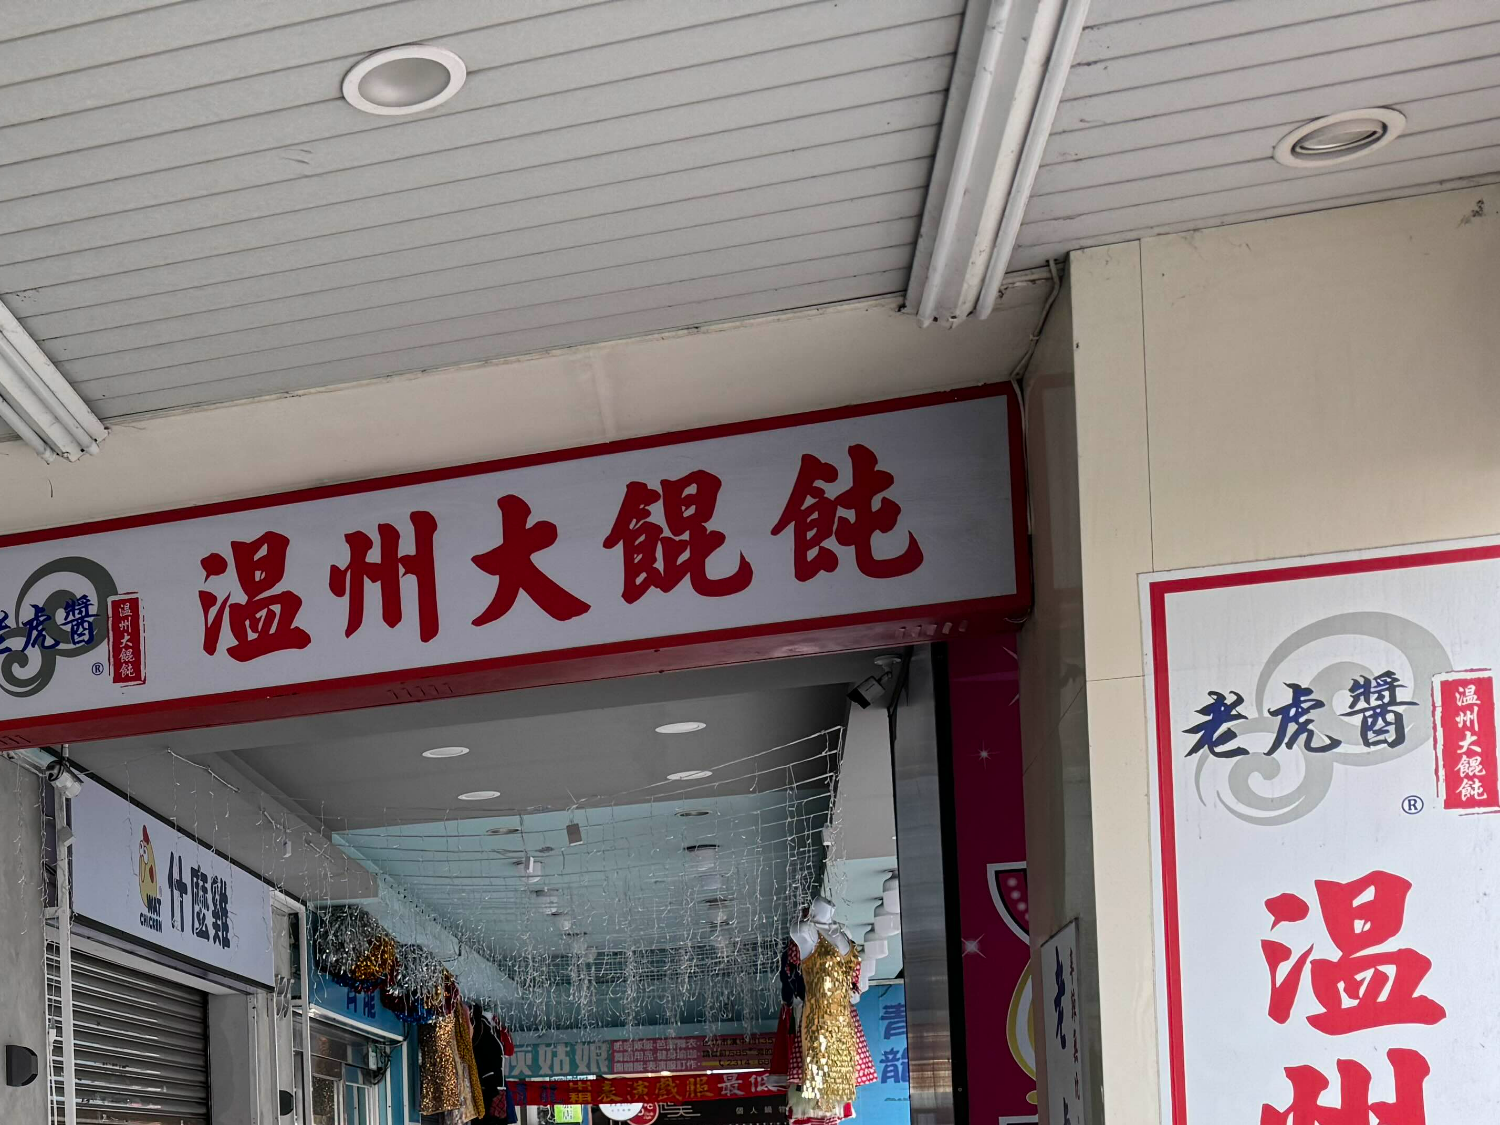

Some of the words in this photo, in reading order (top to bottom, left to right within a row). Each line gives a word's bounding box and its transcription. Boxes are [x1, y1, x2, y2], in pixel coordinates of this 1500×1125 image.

[199, 442, 926, 663] 温州大餛飩
[1182, 669, 1420, 759] 老虎醬
[140, 912, 163, 934] CHICKEN
[146, 893, 162, 918] WAT
